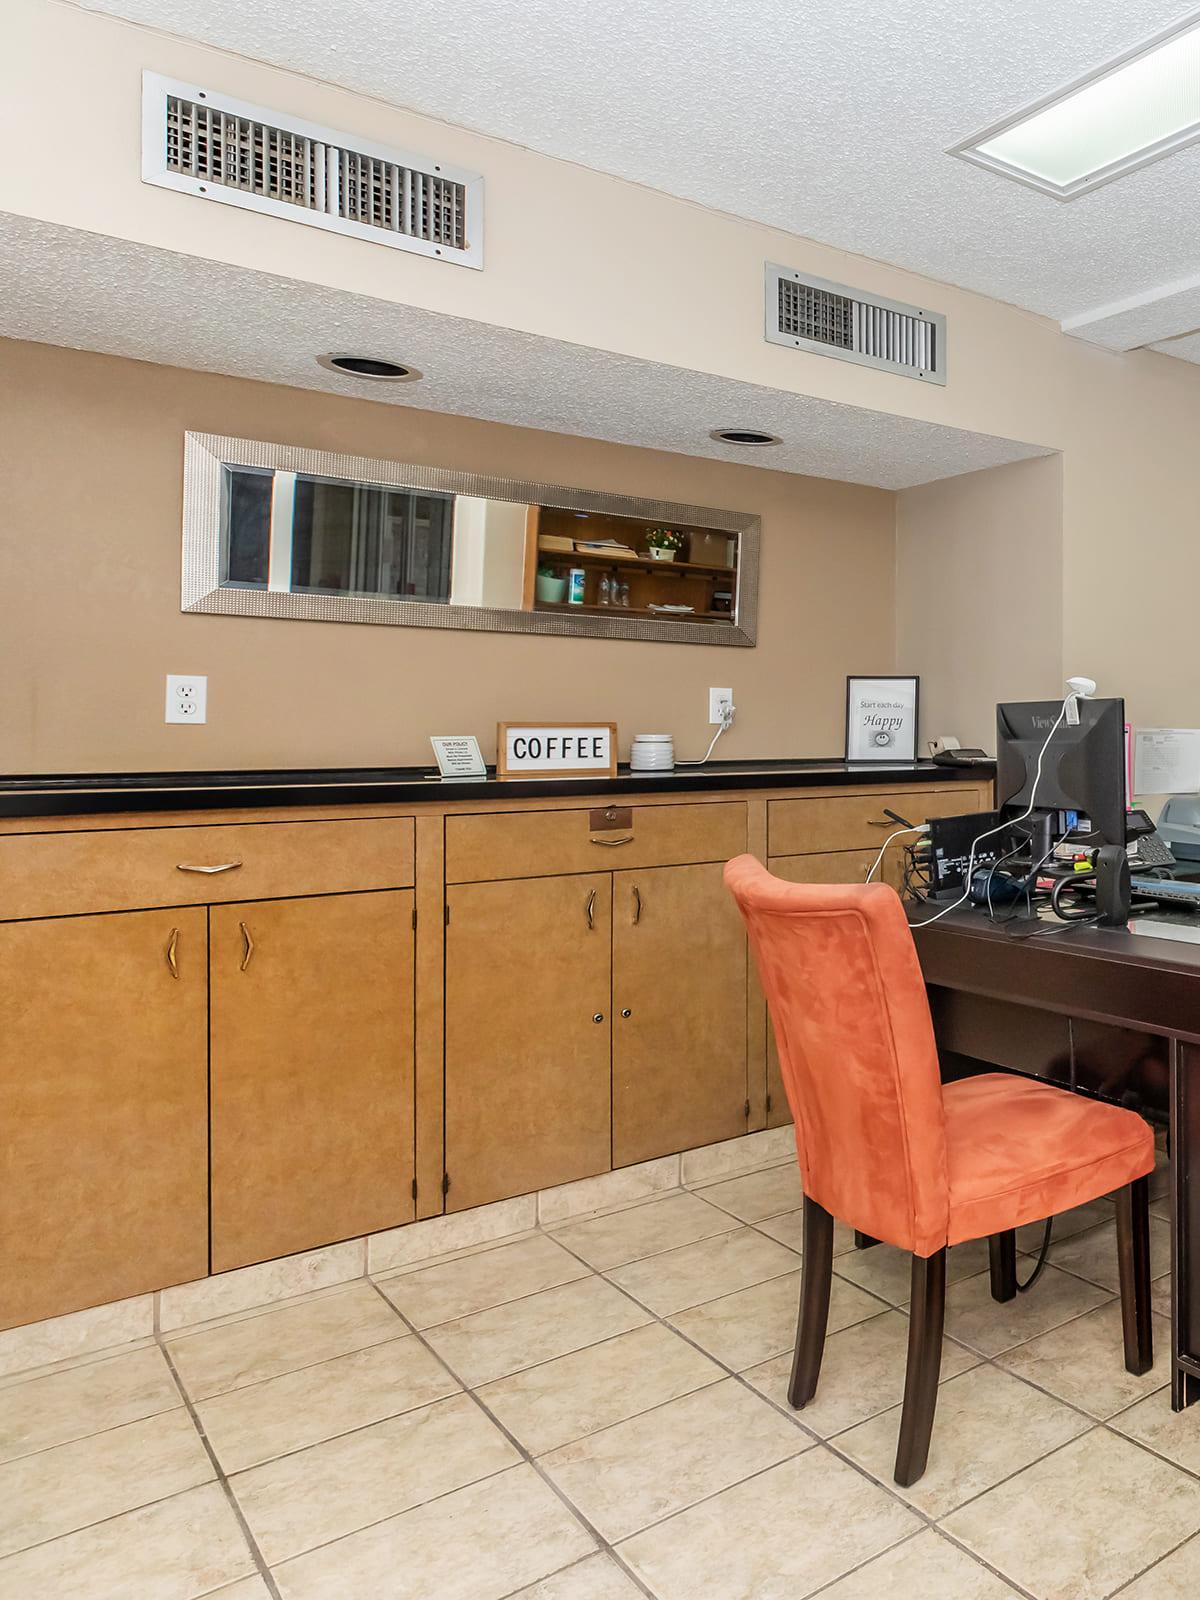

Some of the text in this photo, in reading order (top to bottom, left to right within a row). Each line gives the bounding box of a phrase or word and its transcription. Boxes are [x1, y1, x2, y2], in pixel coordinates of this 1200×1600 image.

[860, 701, 875, 709] Start
[892, 702, 904, 710] day
[863, 713, 903, 731] Happy
[513, 737, 604, 759] COFFEE
